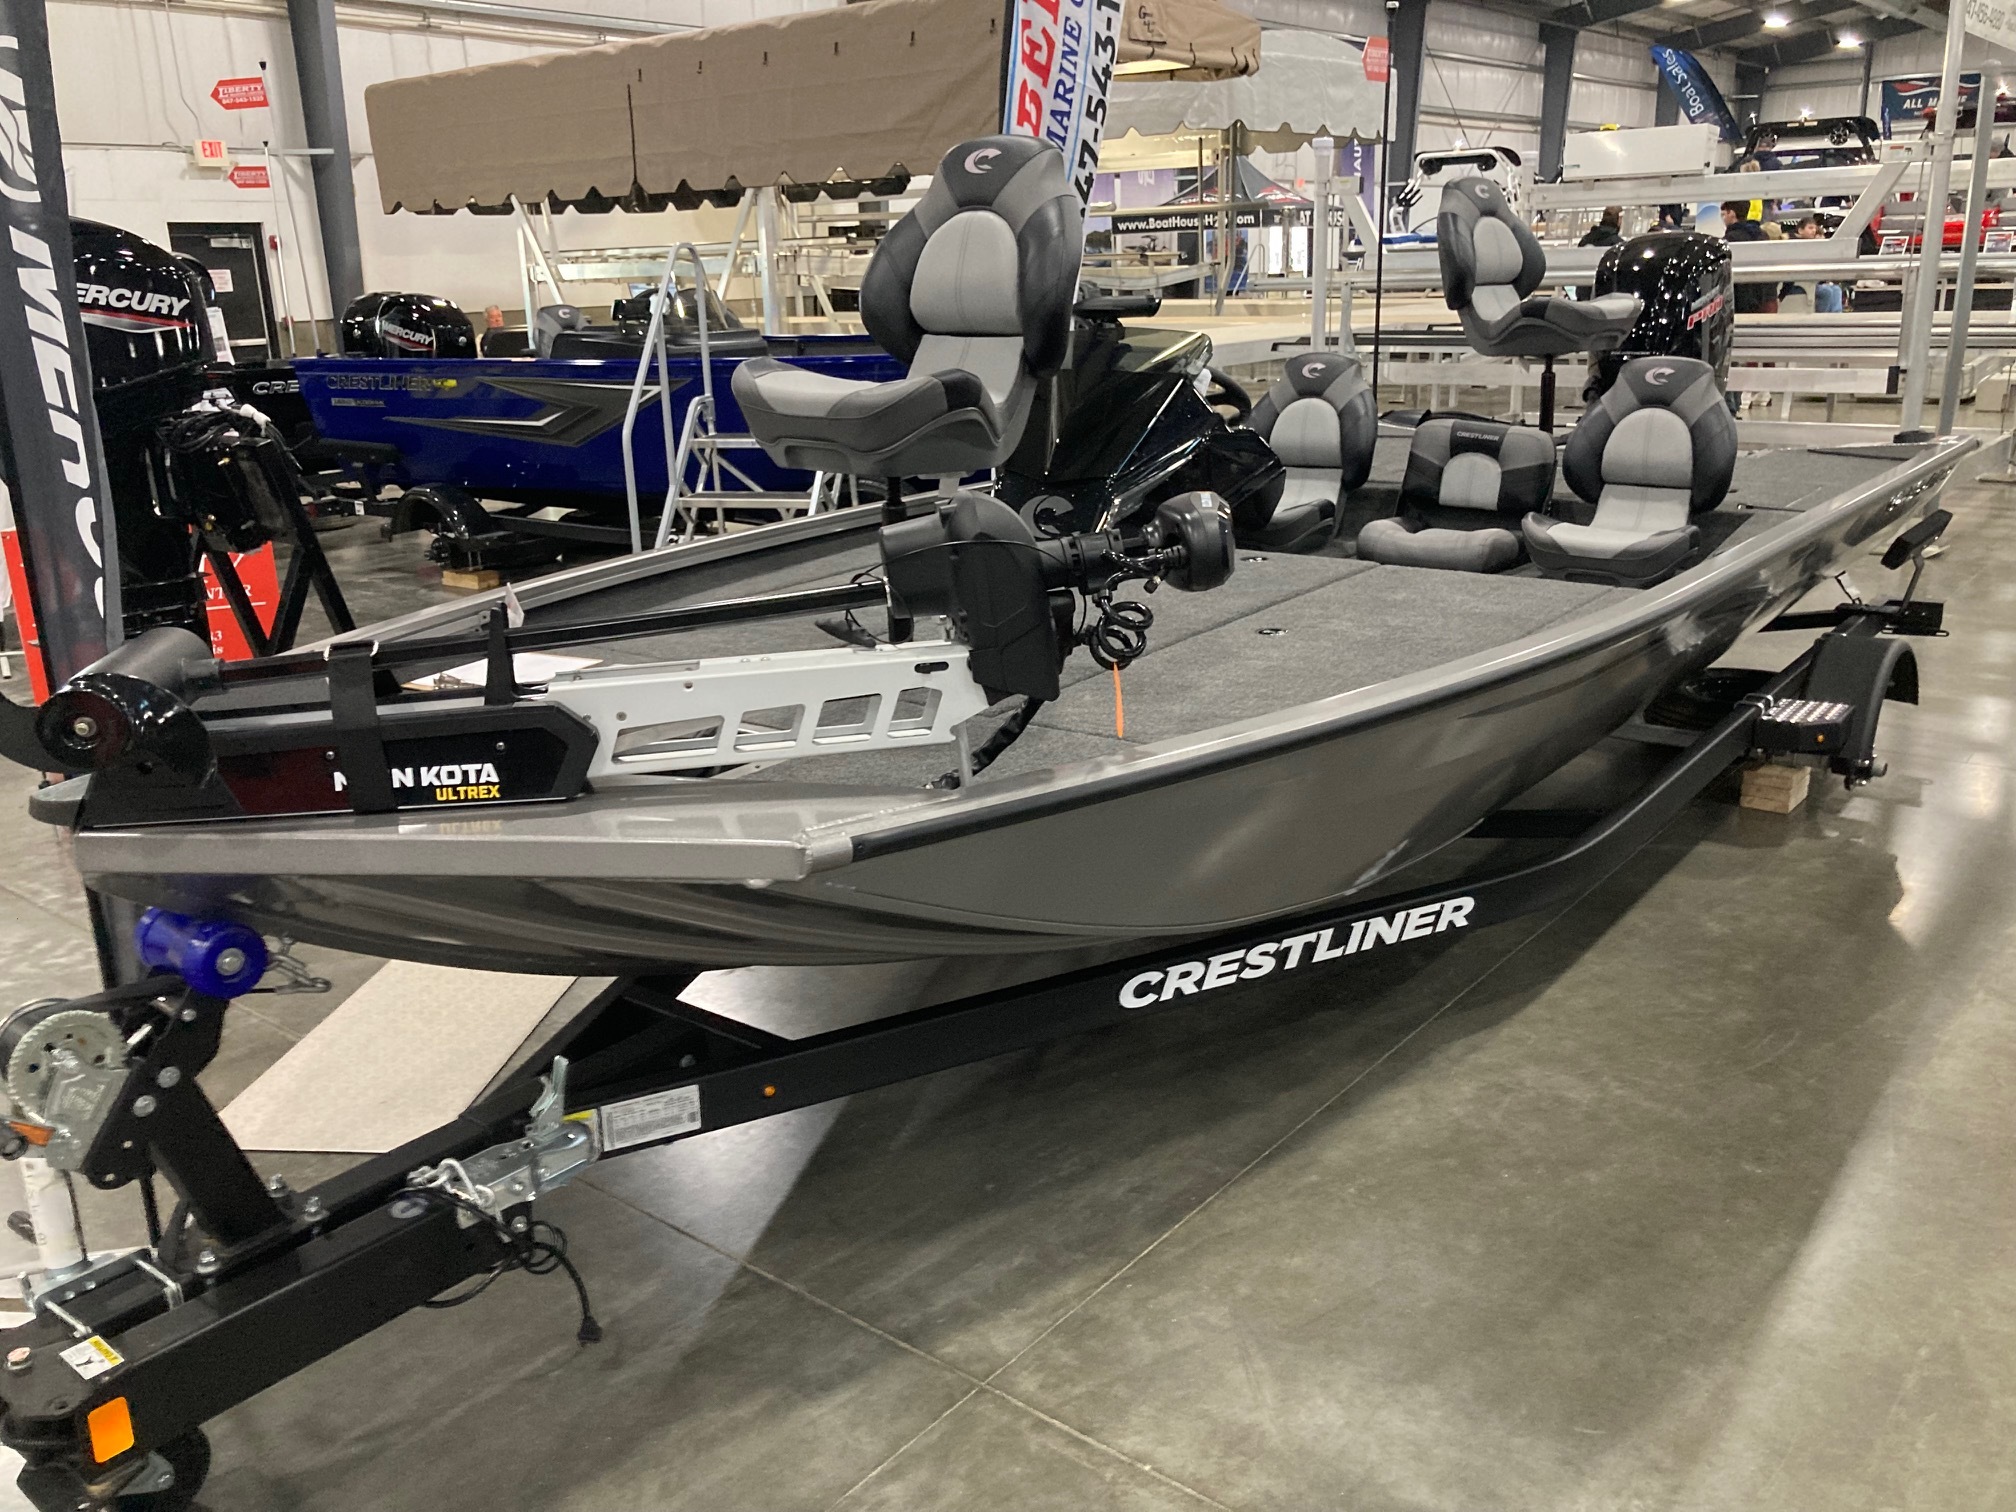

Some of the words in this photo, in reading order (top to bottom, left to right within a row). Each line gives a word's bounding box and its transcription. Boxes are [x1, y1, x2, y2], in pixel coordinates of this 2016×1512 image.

[1662, 48, 1688, 85] Sales
[218, 84, 263, 99] LIBERTY
[1681, 81, 1705, 117] Boat
[1903, 98, 1923, 109] ALL
[202, 141, 223, 158] EXIT
[76, 282, 190, 316] ERCURY
[381, 320, 434, 345] MERCURY
[327, 375, 433, 391] CRESTLINER
[1456, 430, 1500, 441] CRESTLINER
[333, 767, 415, 792] MN
[419, 762, 500, 787] KOTA
[435, 785, 501, 801] ULTREX
[1118, 896, 1475, 1009] CRESTLINER
